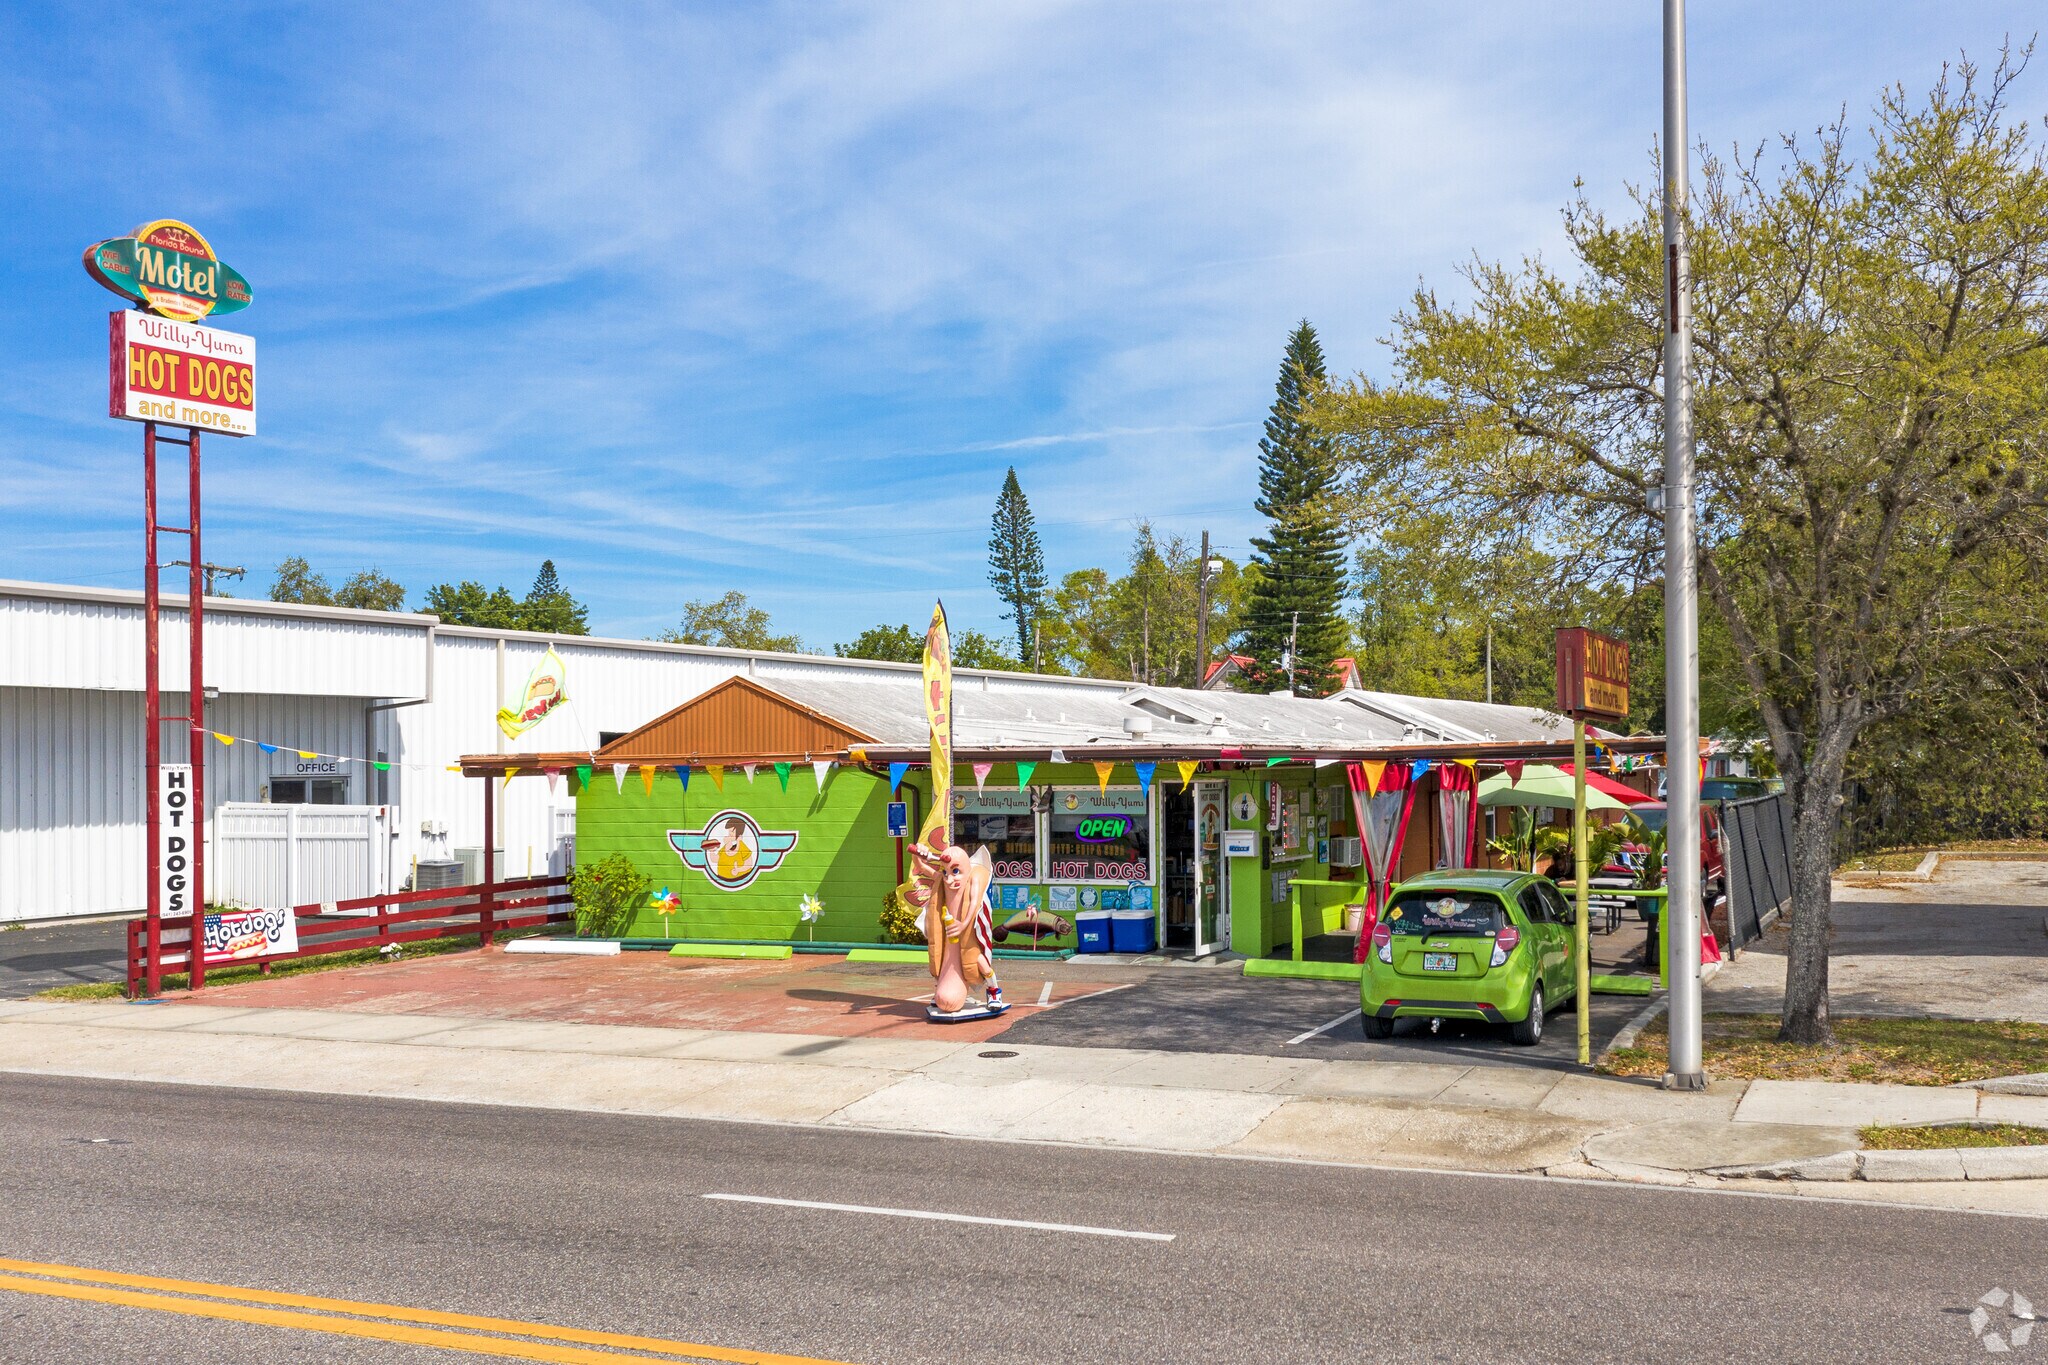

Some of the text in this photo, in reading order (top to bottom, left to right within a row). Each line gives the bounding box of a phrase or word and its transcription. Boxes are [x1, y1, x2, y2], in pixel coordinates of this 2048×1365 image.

[150, 234, 205, 256] Florida Bound
[101, 261, 131, 275] CABLE
[135, 246, 218, 298] Motel
[226, 280, 245, 291] LOW
[226, 290, 251, 303] RATES
[139, 318, 243, 355] Willy-Yums
[129, 346, 254, 406] HOT DOGS
[138, 400, 247, 431] and more...
[1586, 635, 1628, 683] HOT DOGS
[296, 763, 336, 773] OFFICE
[977, 797, 1029, 810] Willy-Yums
[1090, 797, 1144, 809] Willy-Yums
[1079, 819, 1126, 837] OPEN
[166, 772, 187, 912] HOT DOGS
[992, 861, 1034, 878] OGS
[1053, 861, 1147, 880] HOT DOGS
[204, 908, 285, 950] Hotdogs
